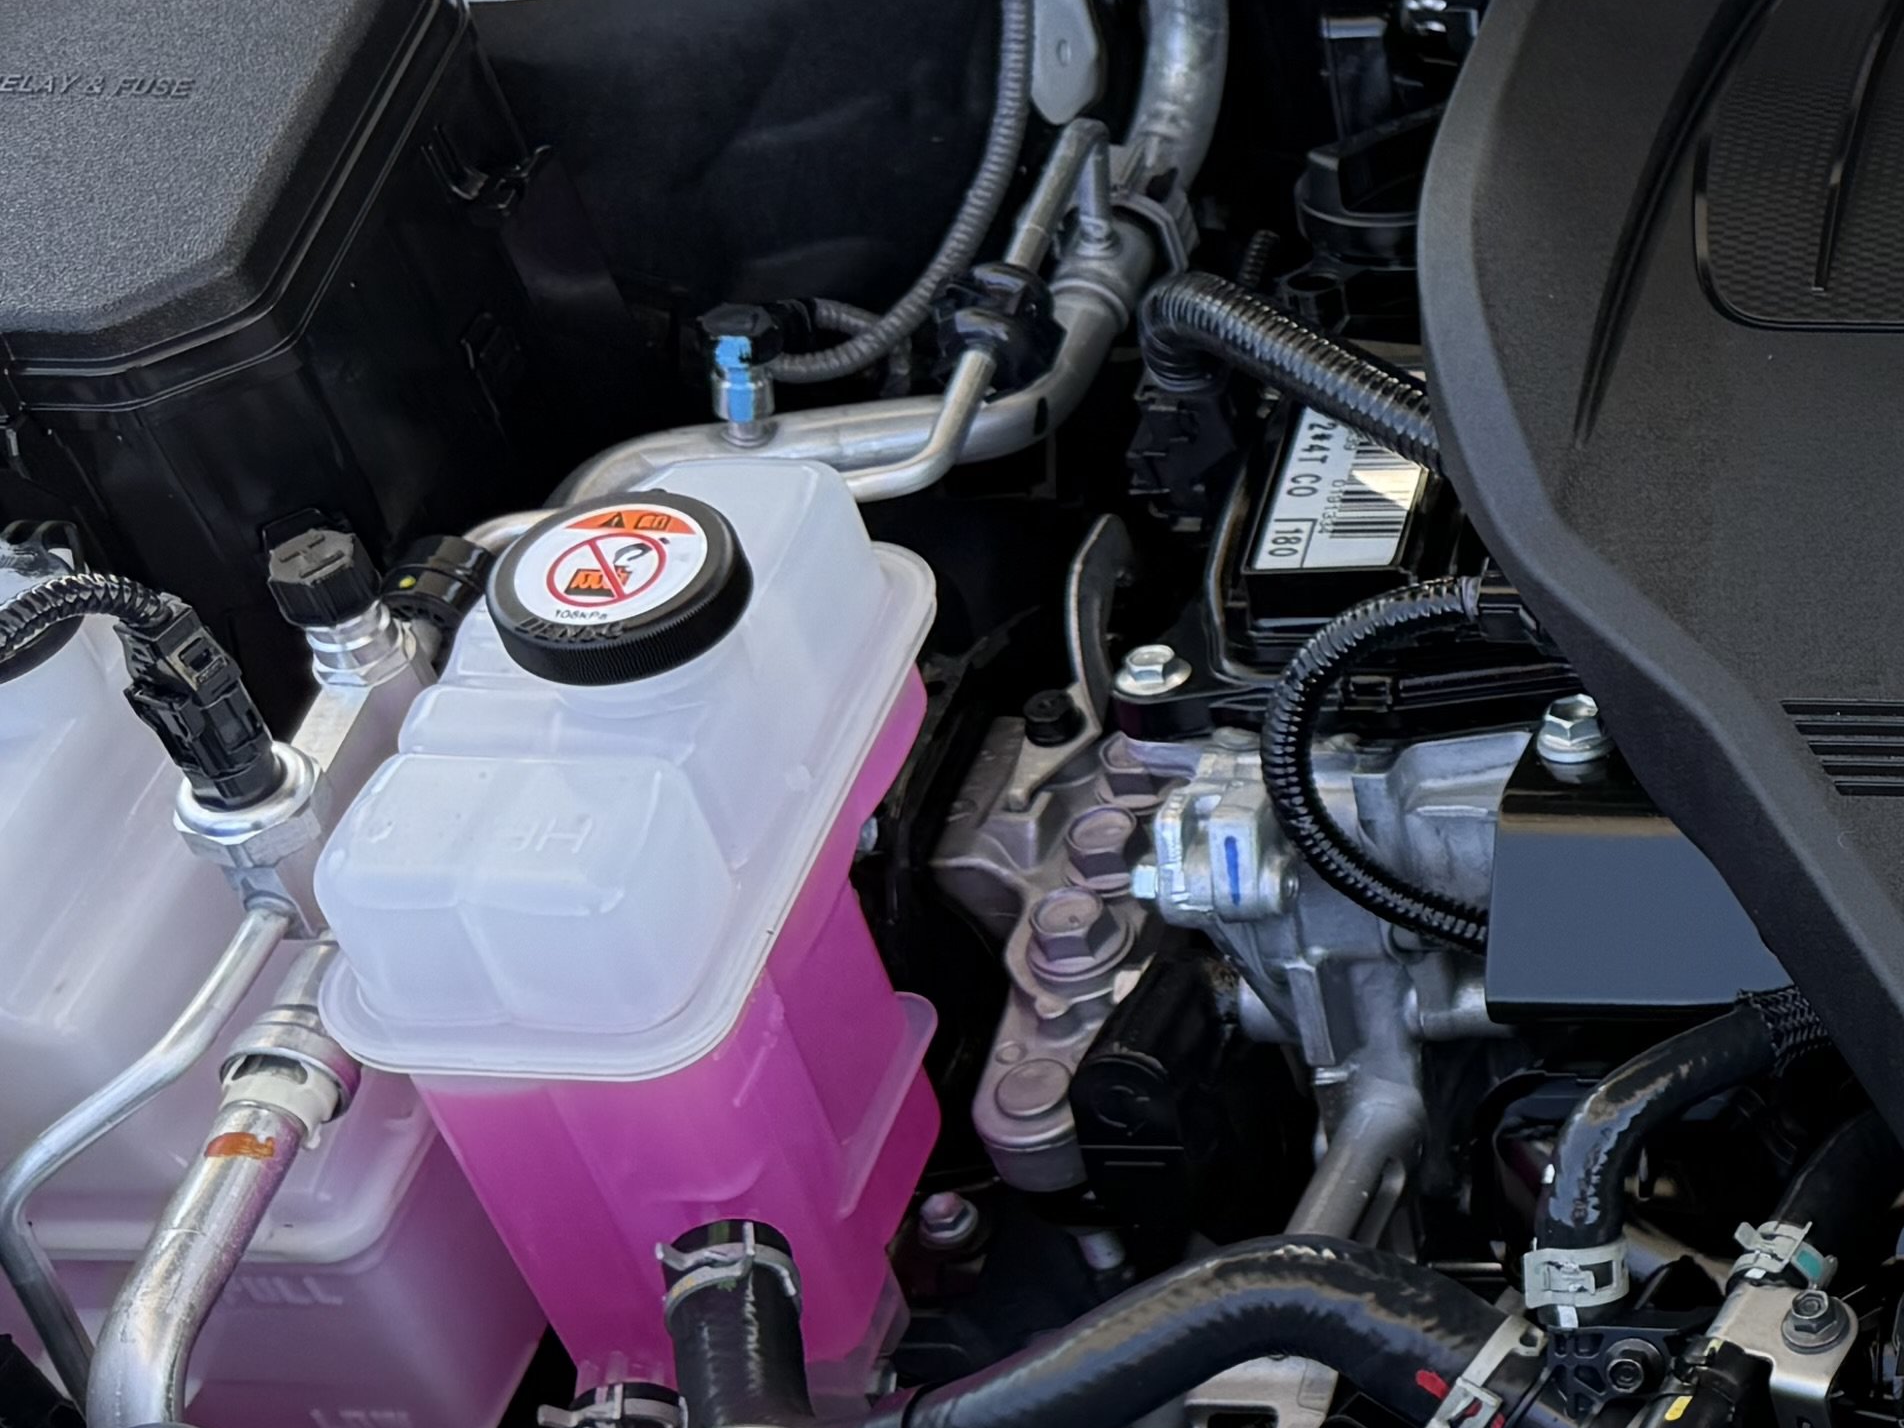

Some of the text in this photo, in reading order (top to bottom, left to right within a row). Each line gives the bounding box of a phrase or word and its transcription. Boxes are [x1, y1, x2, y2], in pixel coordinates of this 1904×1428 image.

[0, 74, 76, 95] ELAY
[115, 77, 195, 99] FUSE
[1269, 529, 1305, 557] 180
